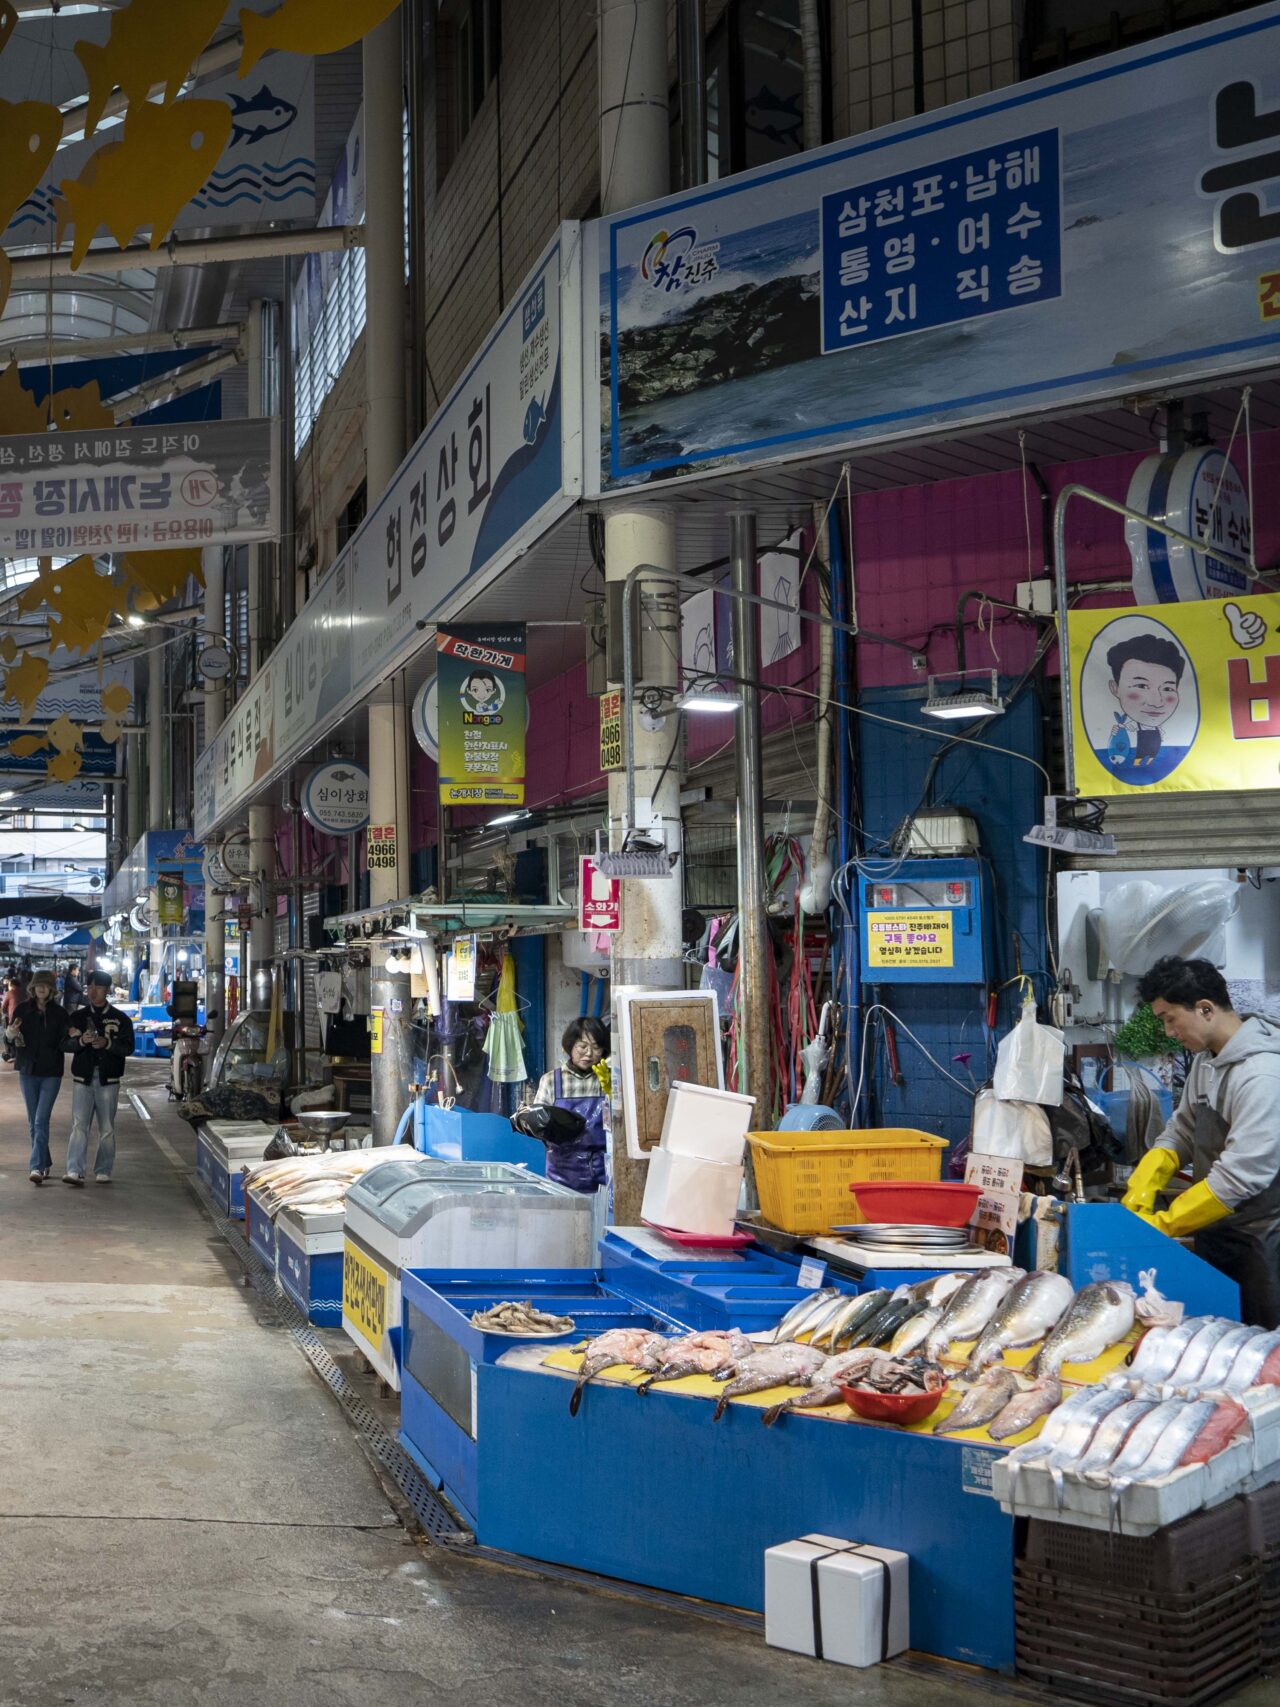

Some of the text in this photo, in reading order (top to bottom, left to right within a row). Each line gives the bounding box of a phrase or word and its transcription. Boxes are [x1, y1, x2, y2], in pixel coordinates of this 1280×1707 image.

[387, 384, 491, 604] 현정상회
[454, 642, 515, 669] 착한가게
[463, 712, 503, 727] Nongae
[601, 723, 620, 747] 4966
[601, 745, 621, 768] 0498
[373, 827, 395, 840] 결혼
[368, 844, 396, 856] 4966
[368, 857, 396, 869] 0498
[585, 902, 619, 911] 소화기
[906, 933, 937, 944] 좋아요
[905, 946, 943, 955] 살겠습니다
